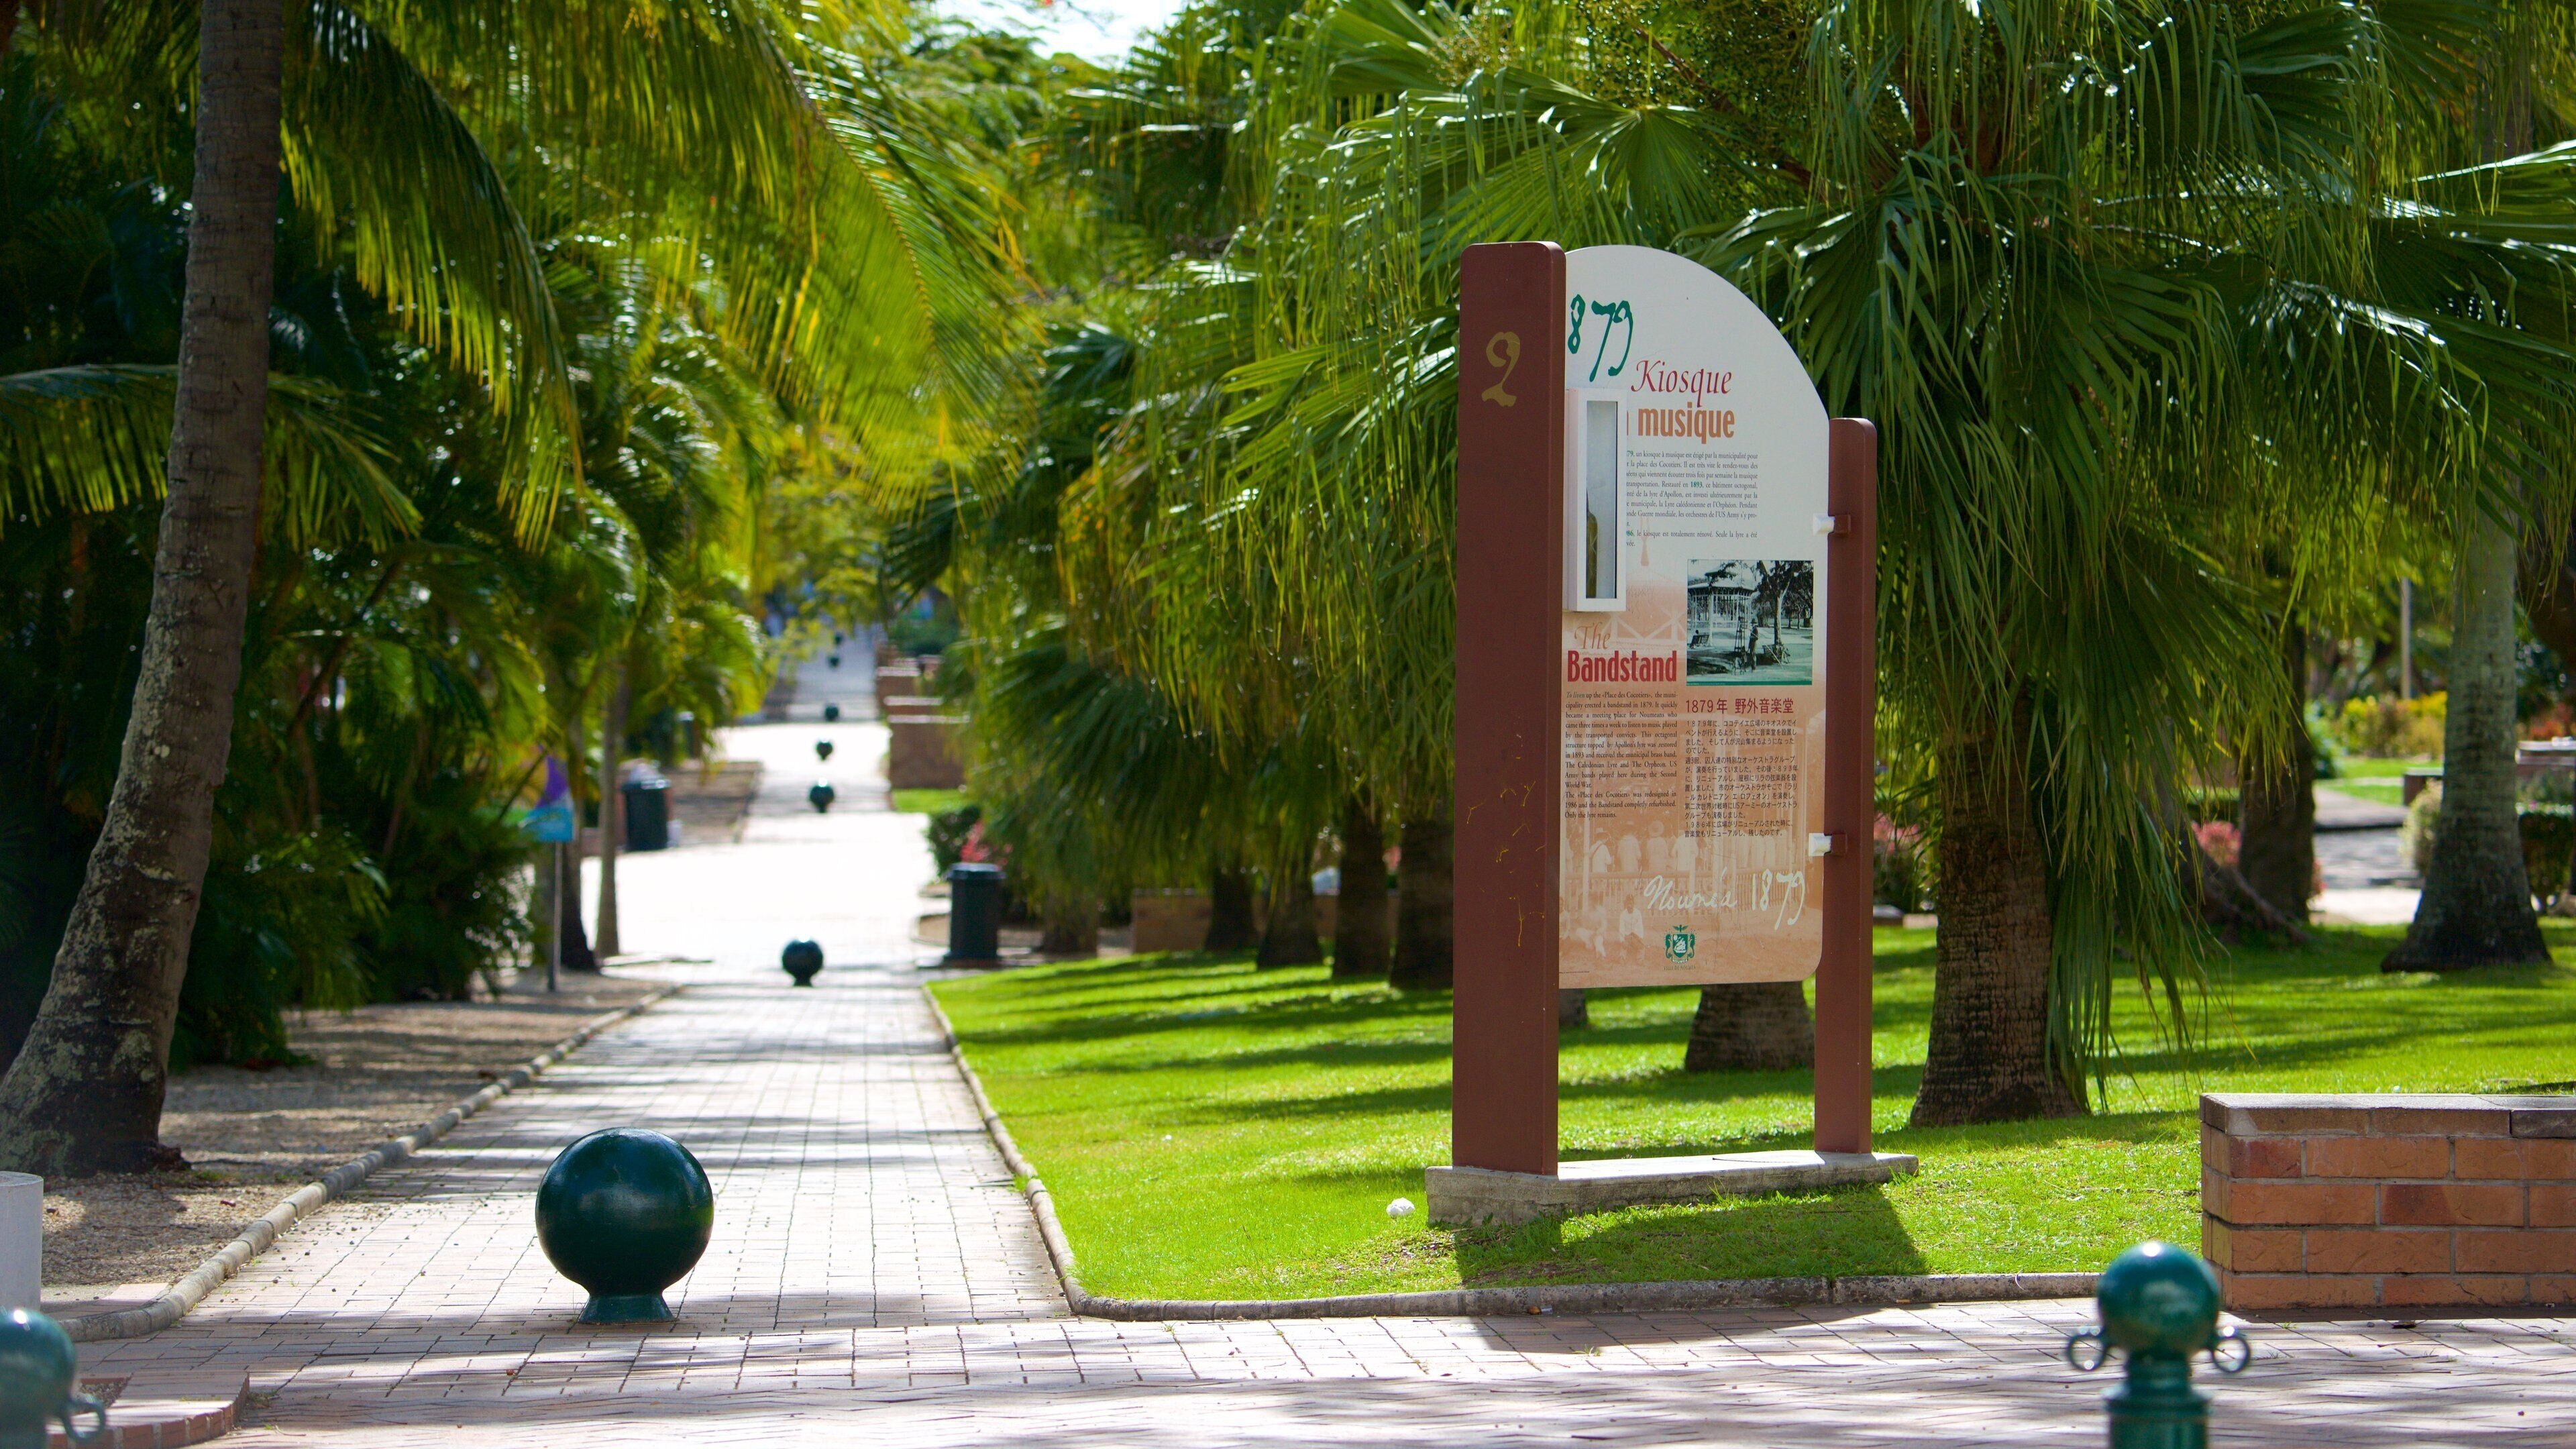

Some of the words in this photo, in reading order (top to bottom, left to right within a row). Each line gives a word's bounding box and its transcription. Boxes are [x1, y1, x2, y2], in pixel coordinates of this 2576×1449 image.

[1567, 294, 1633, 382] 879
[1481, 331, 1521, 407] 2
[1631, 360, 1732, 408] Kiosque
[1638, 402, 1735, 444] musique
[1643, 451, 1660, 460] kiosque
[1665, 451, 1684, 460] musique
[1693, 451, 1704, 460] érigé
[1718, 452, 1746, 461] municipalité
[1636, 461, 1648, 470] place
[1638, 470, 1646, 479] qui
[1738, 472, 1758, 480] musique
[1649, 490, 1658, 499] lyre
[1664, 500, 1674, 509] Lyre
[1726, 511, 1739, 520] Army
[1643, 530, 1660, 539] kiosque
[1735, 531, 1743, 539] lyre
[1574, 621, 1611, 649] The
[1567, 650, 1677, 682] Bandstand
[1566, 702, 1582, 710] cipality
[1660, 701, 1676, 710] quickly
[1686, 698, 1728, 714] 1879年
[1735, 698, 1794, 714] 野外音楽堂
[1592, 711, 1611, 720] meeting
[1613, 711, 1626, 720] place
[1662, 721, 1677, 730] played
[1565, 731, 1571, 740] by
[1586, 731, 1613, 740] transported
[1654, 731, 1677, 739] octagonal
[1587, 741, 1604, 750] topped
[1607, 741, 1613, 750] by
[1637, 741, 1646, 749] lyre
[1625, 751, 1649, 759] municipal
[1607, 761, 1617, 769] Lyre
[1565, 771, 1578, 780] Army
[1599, 771, 1614, 780] played
[1630, 771, 1646, 780] during
[1644, 790, 1668, 799] redesigned
[1564, 811, 1576, 820] Only
[1587, 811, 1596, 820] lyre
[1644, 866, 1738, 912] Nouméa
[1752, 868, 1807, 930] 1879
